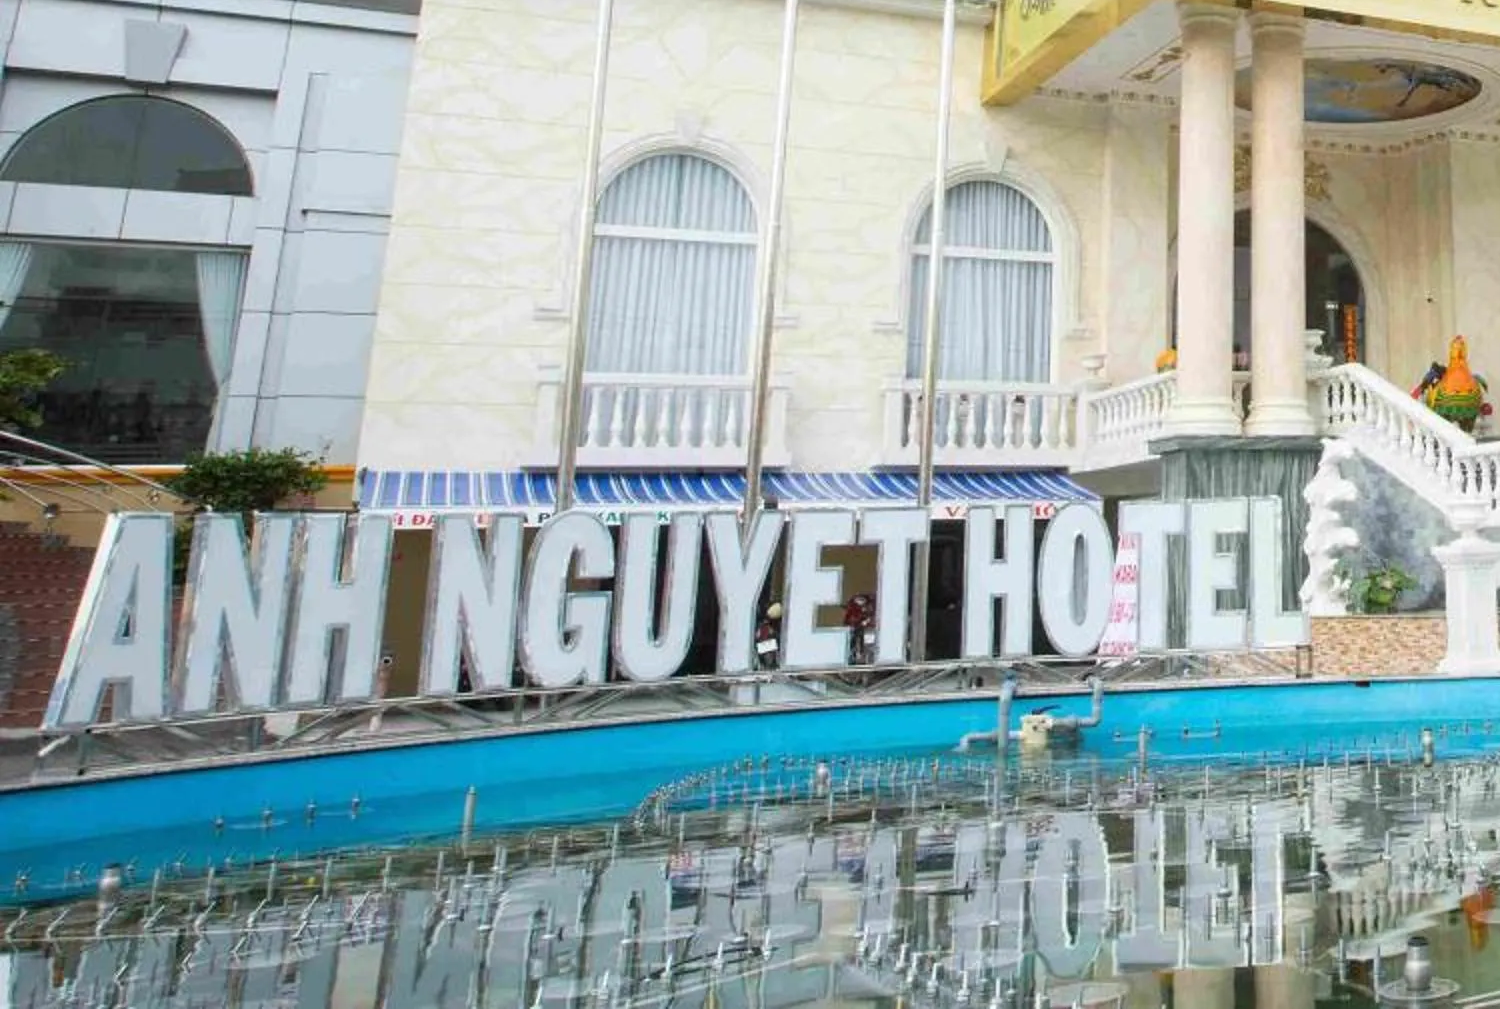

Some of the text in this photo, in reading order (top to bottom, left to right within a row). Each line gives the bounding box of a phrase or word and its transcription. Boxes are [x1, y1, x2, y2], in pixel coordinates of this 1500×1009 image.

[40, 511, 396, 733] ANH
[418, 504, 930, 701] NGUYET
[960, 493, 1313, 660] HOTEL
